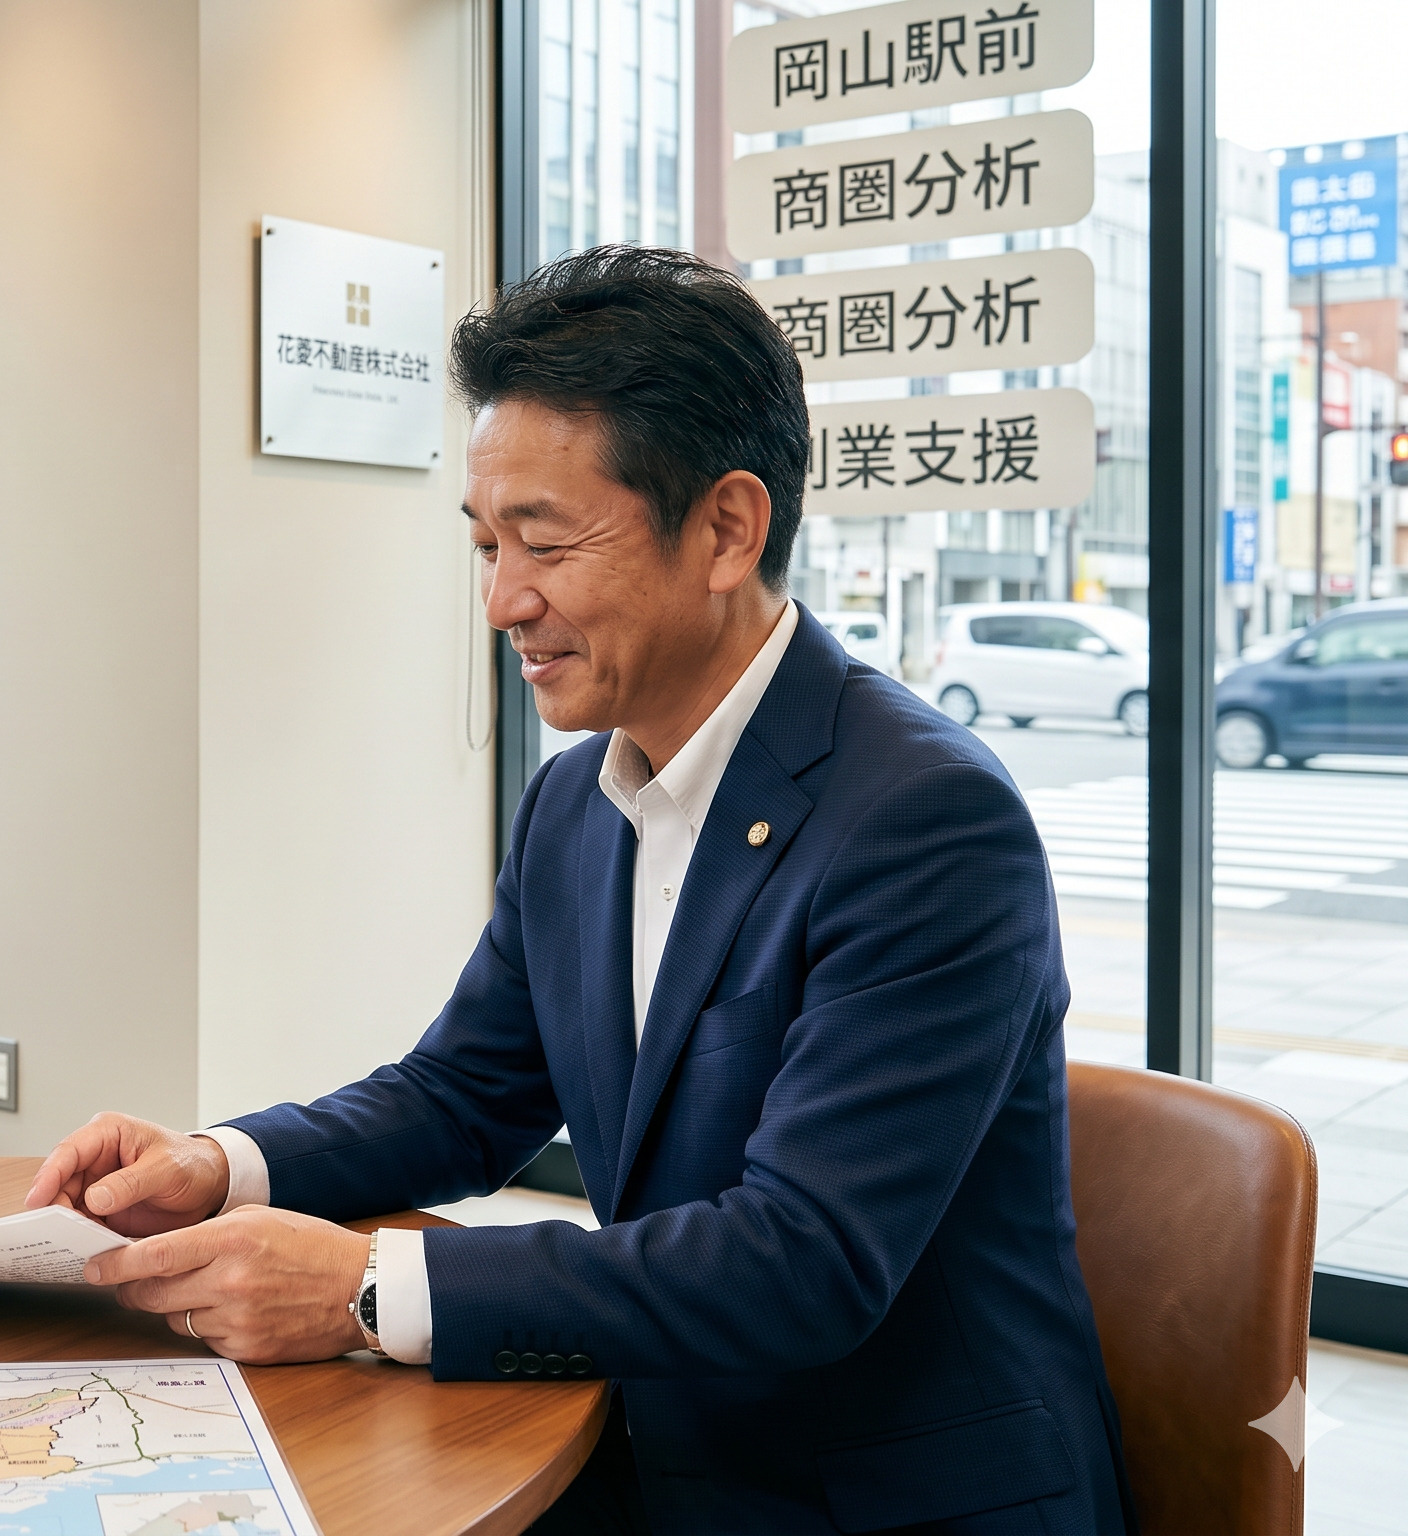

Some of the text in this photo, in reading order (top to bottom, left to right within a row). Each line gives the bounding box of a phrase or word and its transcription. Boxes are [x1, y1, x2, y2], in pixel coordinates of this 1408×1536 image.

[774, 2, 1040, 107] 岡山駅前
[773, 138, 1040, 234] 商圏分析
[808, 415, 1039, 490] 業支援
